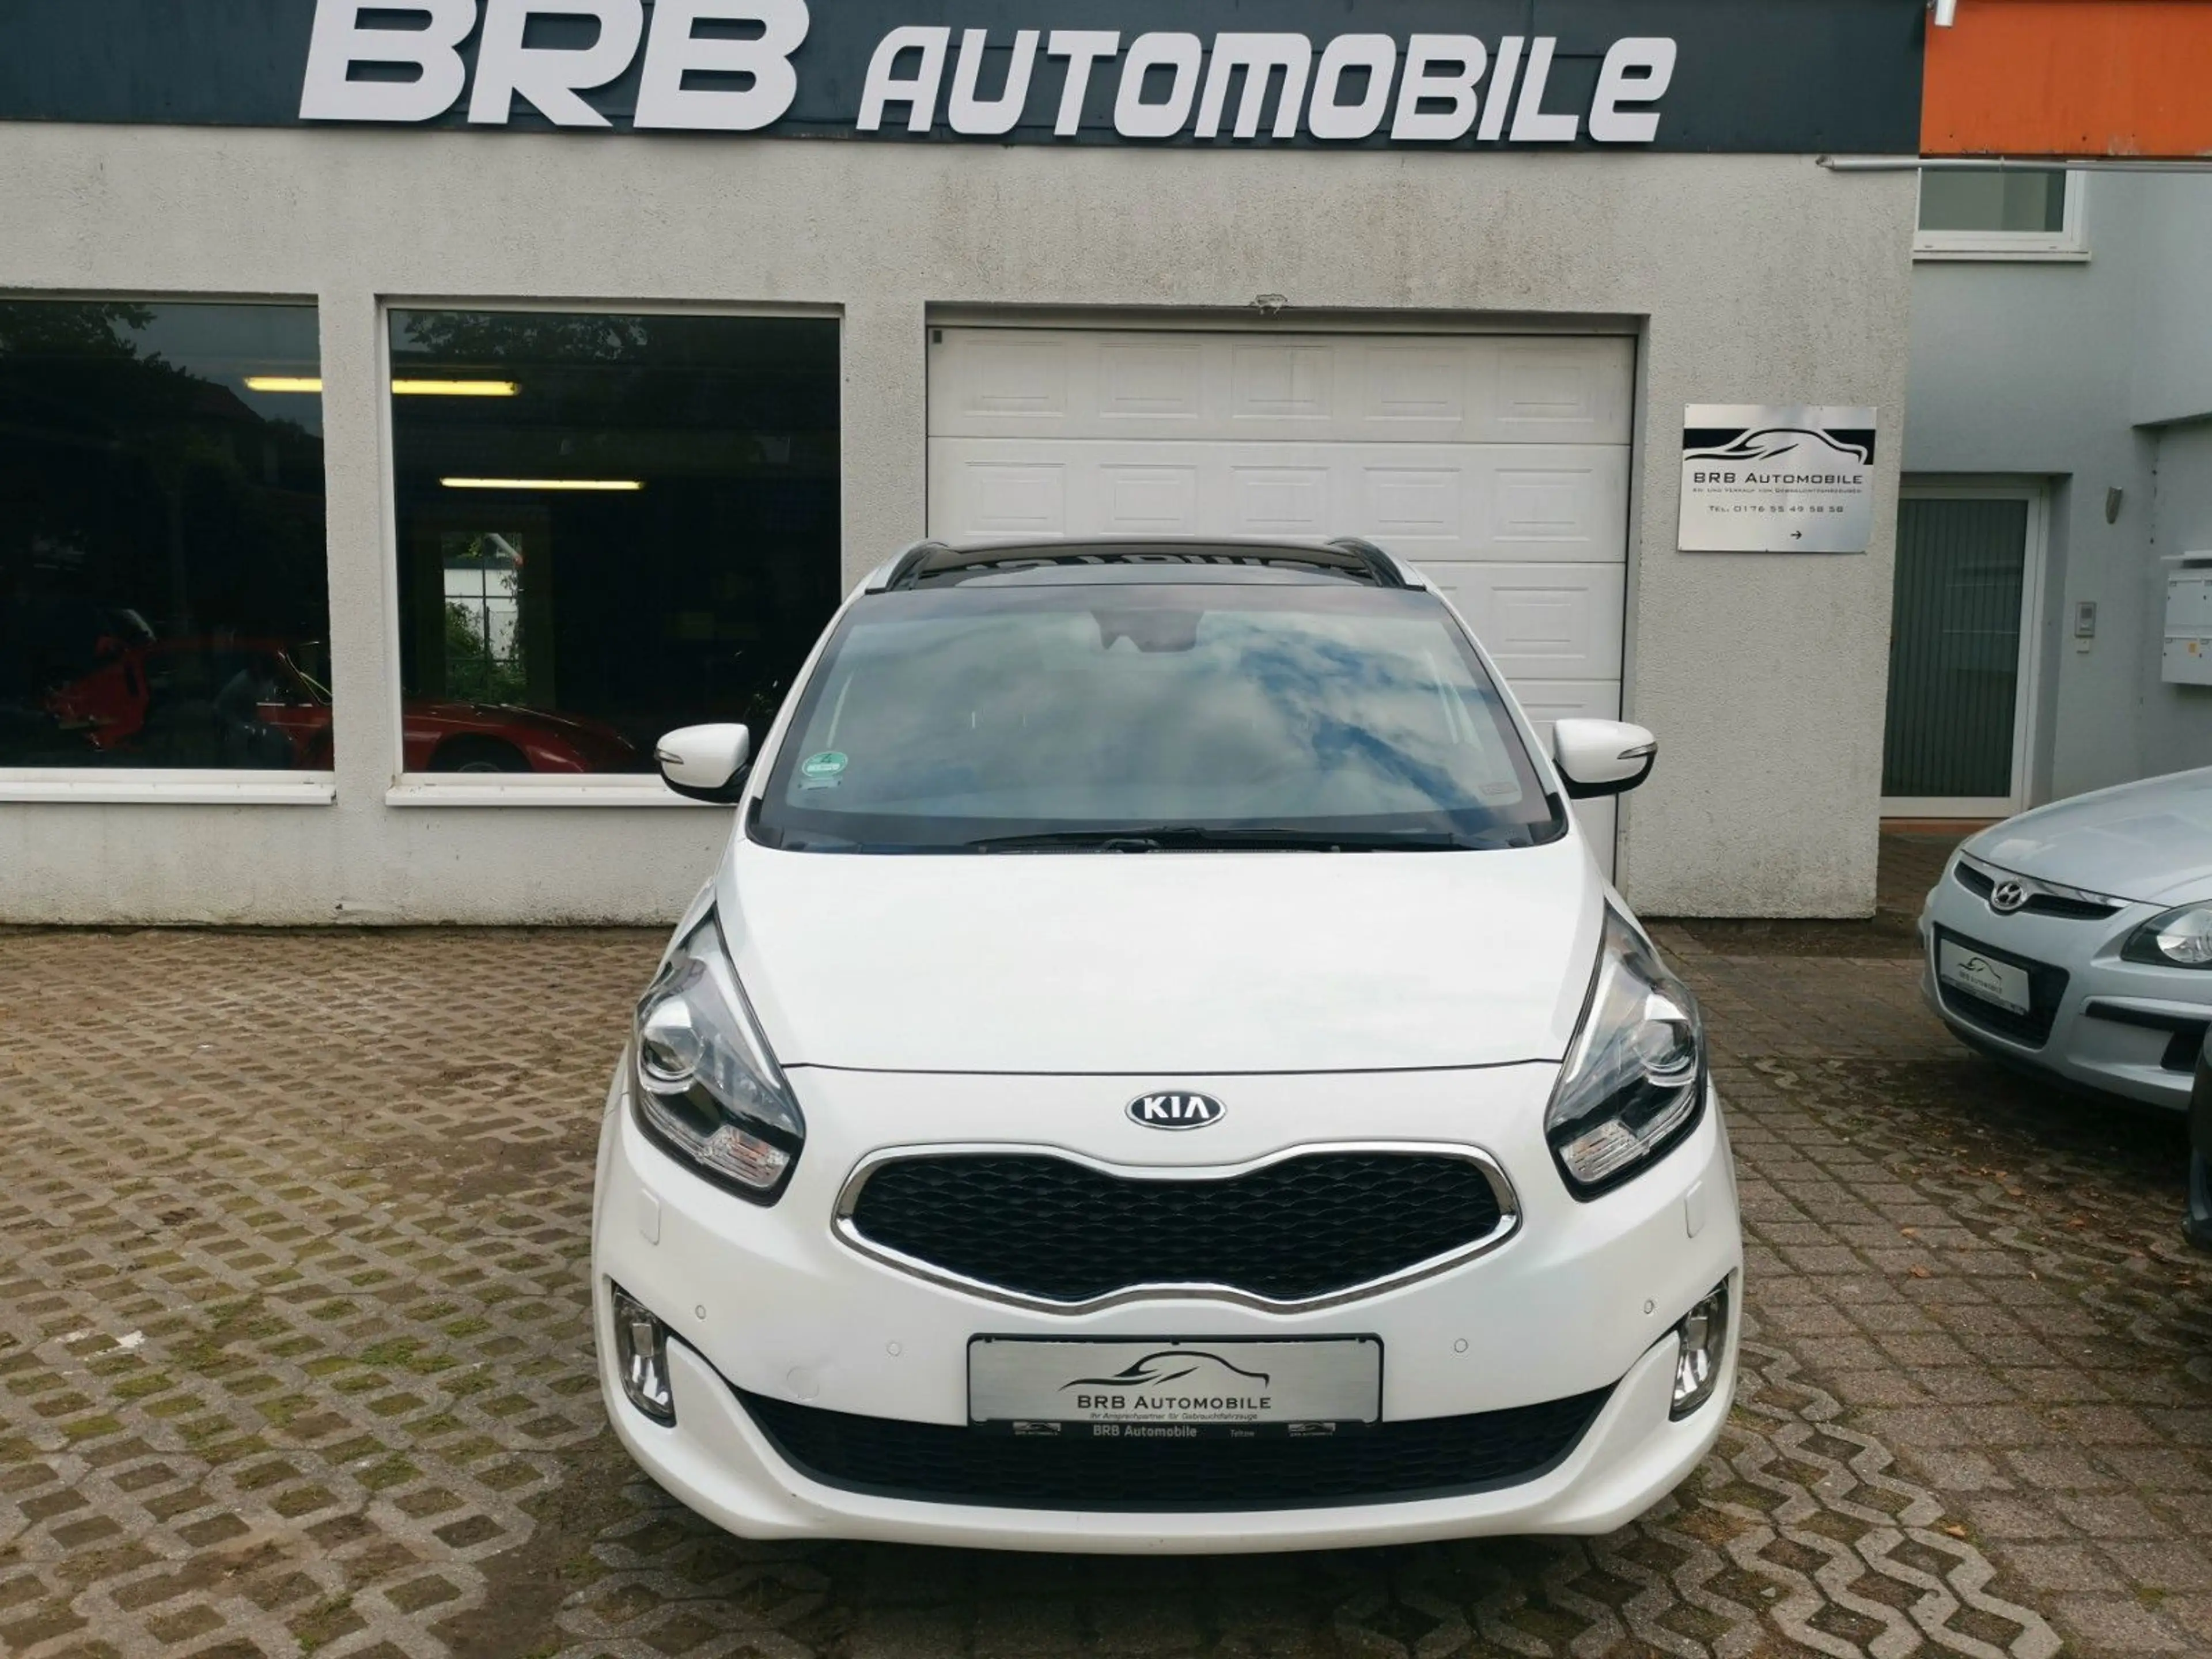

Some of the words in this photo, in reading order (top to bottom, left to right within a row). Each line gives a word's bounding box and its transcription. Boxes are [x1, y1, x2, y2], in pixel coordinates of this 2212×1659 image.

[298, 0, 809, 130] BRB
[1694, 472, 1736, 483] BRB
[1745, 472, 1862, 484] AUTOMOBILE
[1143, 1096, 1210, 1119] KIA
[1077, 1395, 1126, 1409] BRB
[1134, 1396, 1271, 1410] AUTOMOBILE
[1093, 1424, 1120, 1436] BRB
[1124, 1425, 1197, 1437] Automobile
